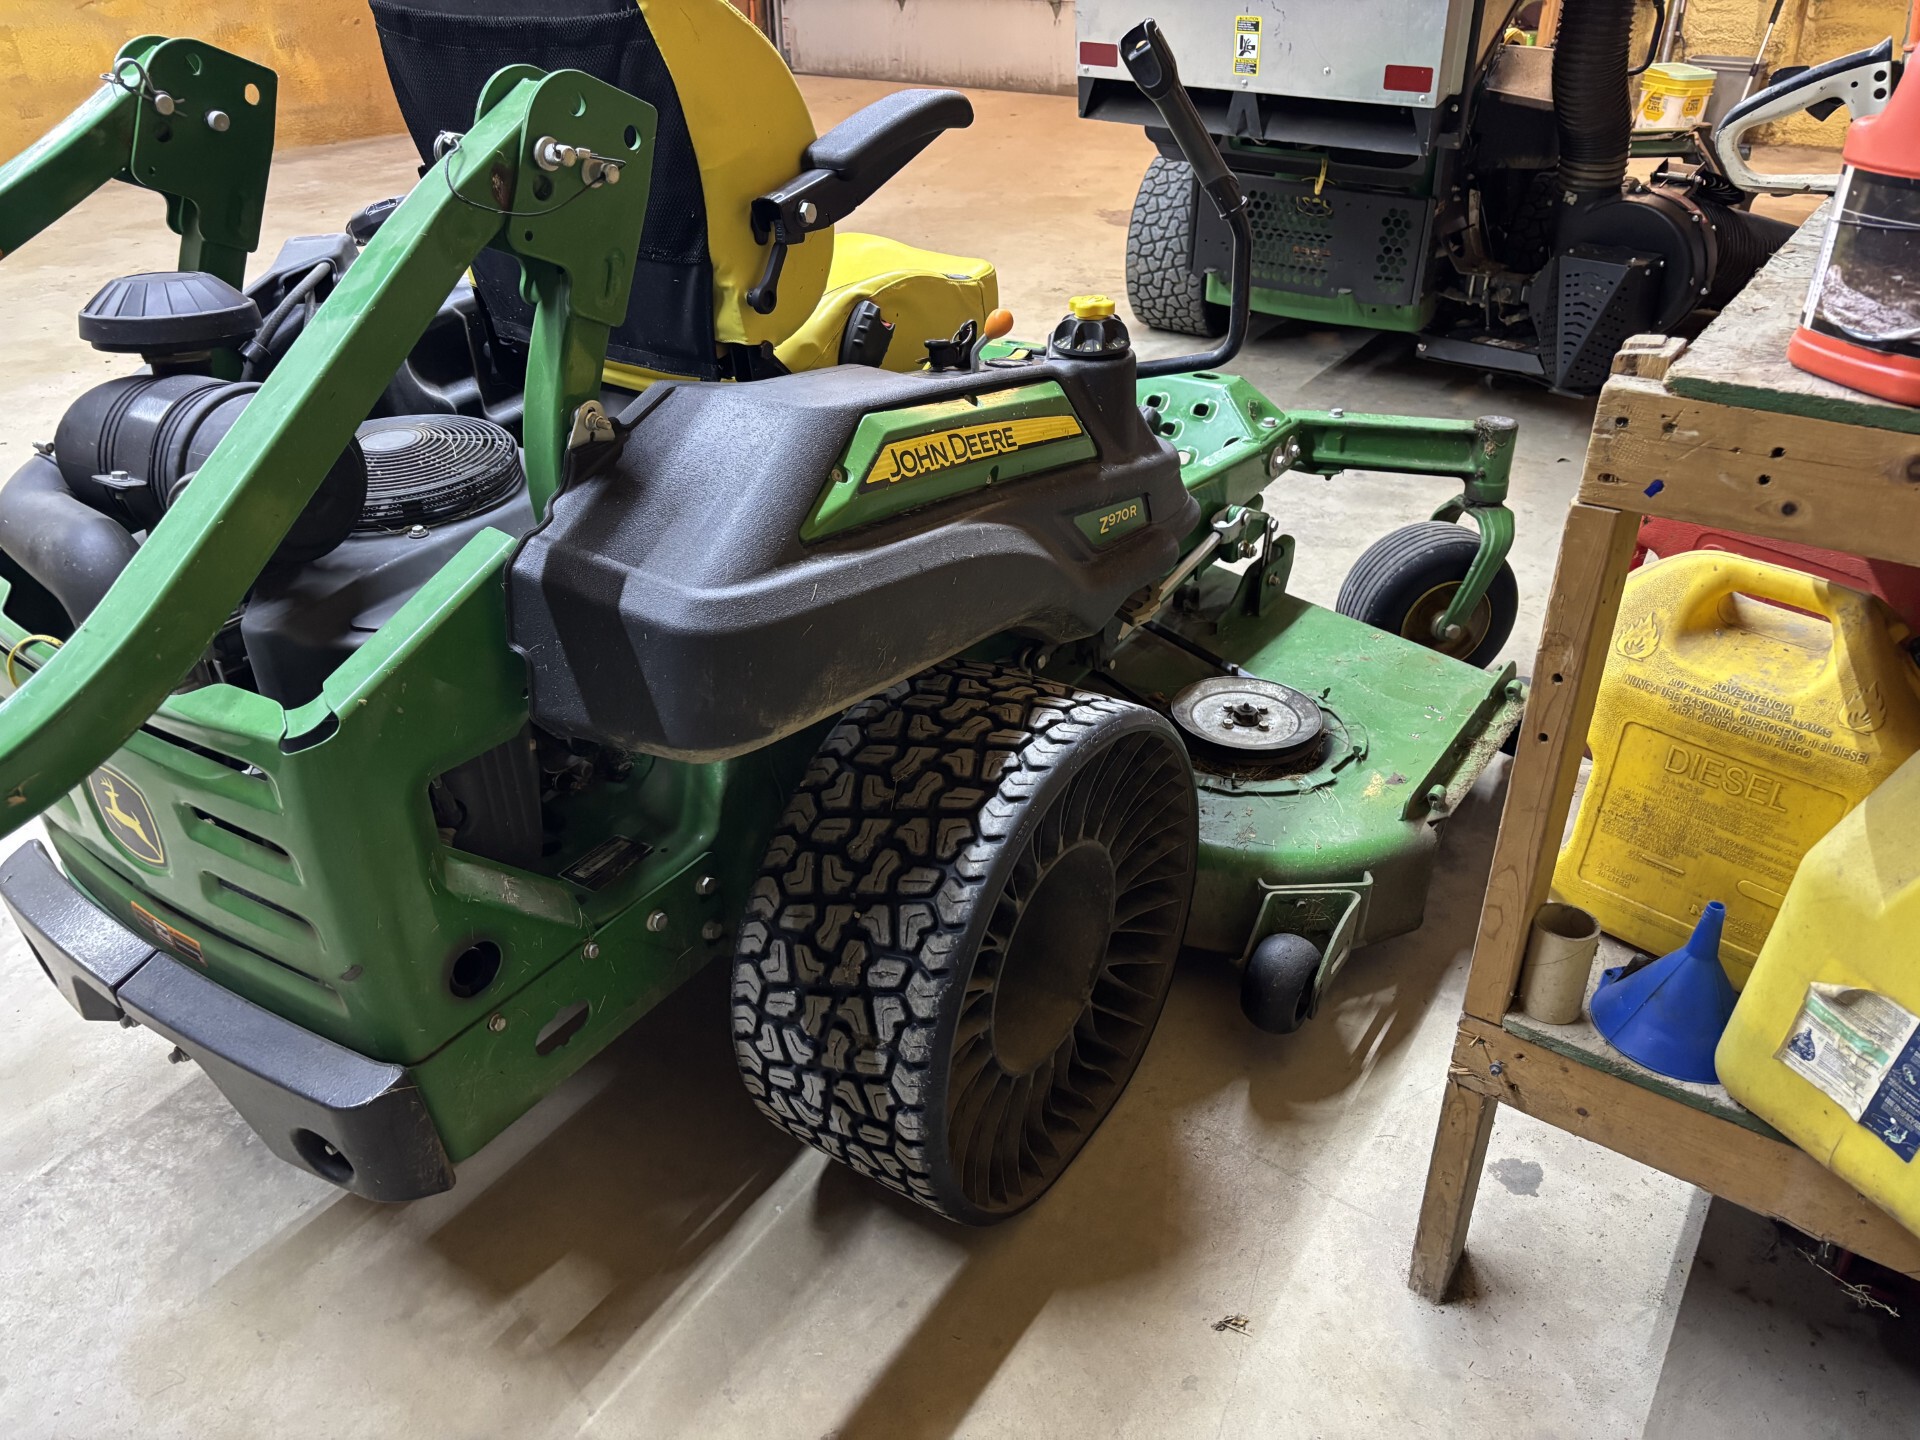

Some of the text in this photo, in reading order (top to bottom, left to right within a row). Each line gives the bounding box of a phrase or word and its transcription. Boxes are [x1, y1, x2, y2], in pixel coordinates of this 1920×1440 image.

[889, 426, 1018, 478] JOHN DEERE
[1099, 504, 1137, 535] Z970R
[1625, 674, 1658, 694] NUNCA
[1659, 686, 1681, 702] USE
[1738, 713, 1806, 744] QUEROSENO
[1830, 744, 1870, 765] DIESEL
[1668, 678, 1690, 691] MUY
[1690, 685, 1740, 708] FLAMABLE
[1776, 713, 1790, 724] DE
[1791, 719, 1833, 738] LLAMAS
[1711, 681, 1794, 716] ADVERTENCIA
[1667, 702, 1812, 759] PARA COMENZAR UN FUEGO
[1664, 744, 1788, 814] DIESEL
